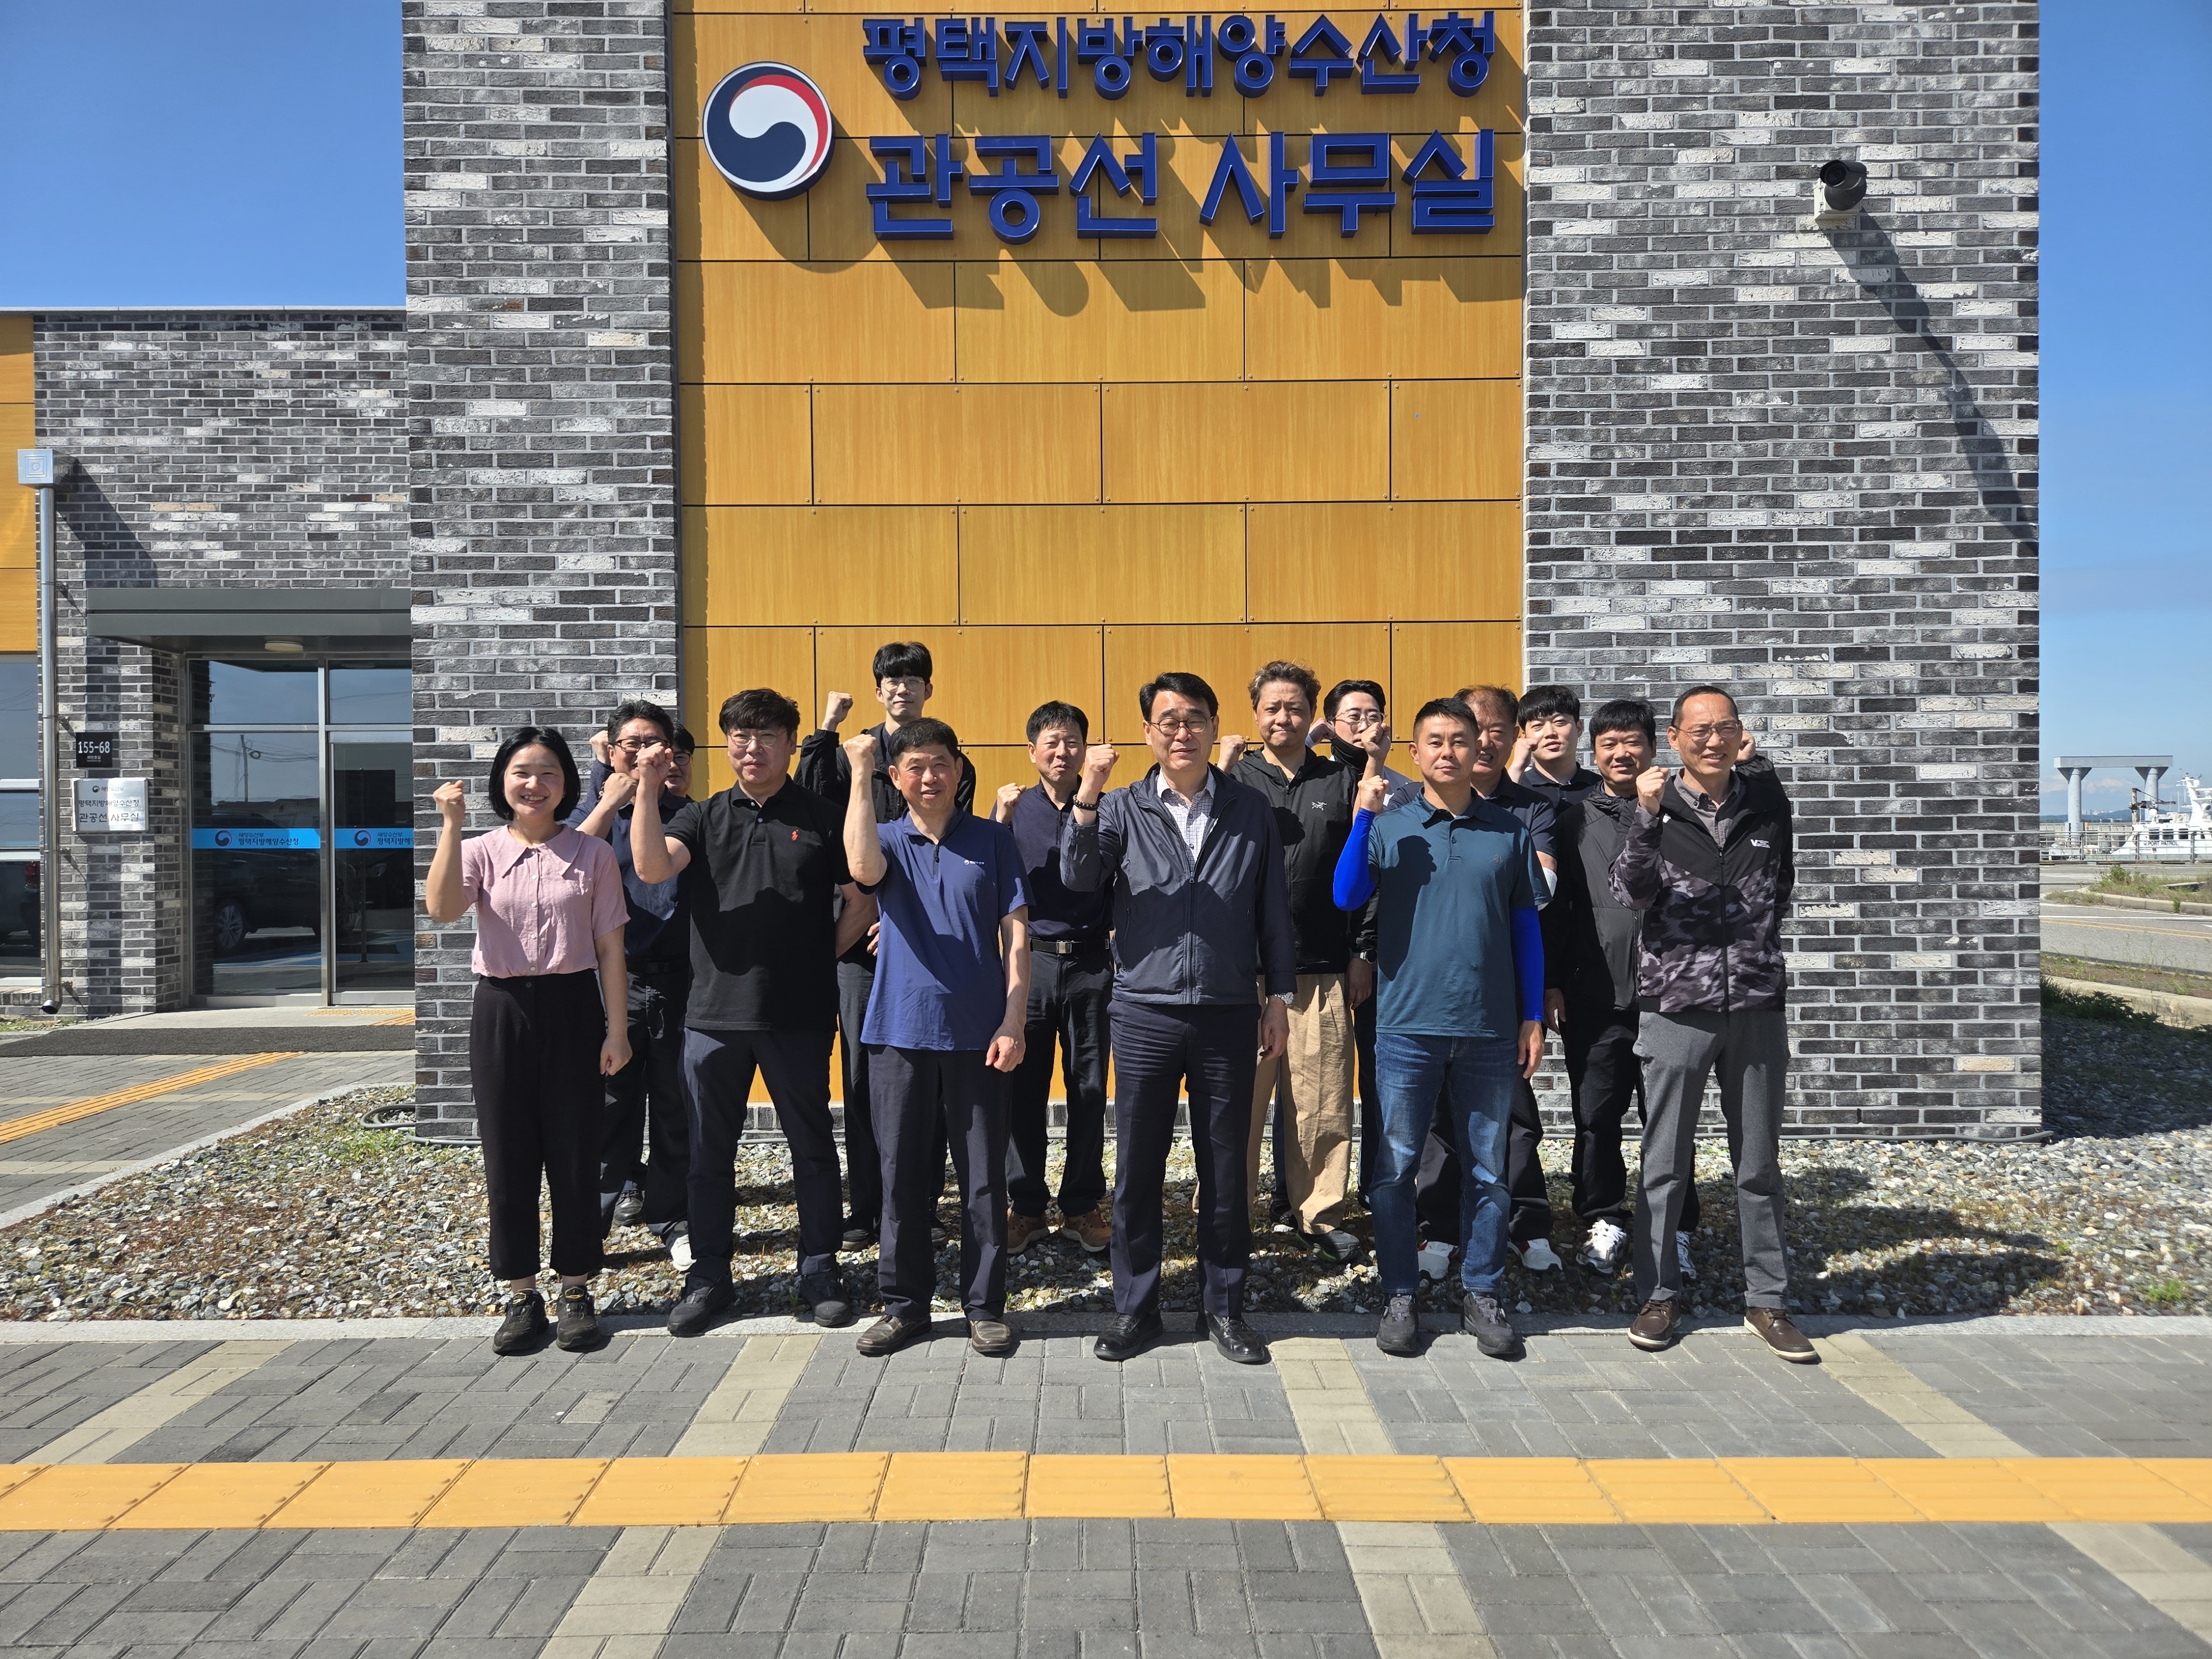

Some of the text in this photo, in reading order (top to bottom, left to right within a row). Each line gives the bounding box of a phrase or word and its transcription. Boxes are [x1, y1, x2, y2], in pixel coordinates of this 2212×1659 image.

[863, 10, 1495, 101] 평택지방해양수산청
[866, 128, 1495, 244] 관공선 사무실
[78, 741, 110, 753] 155-68
[79, 813, 139, 823] 관공선 사무실
